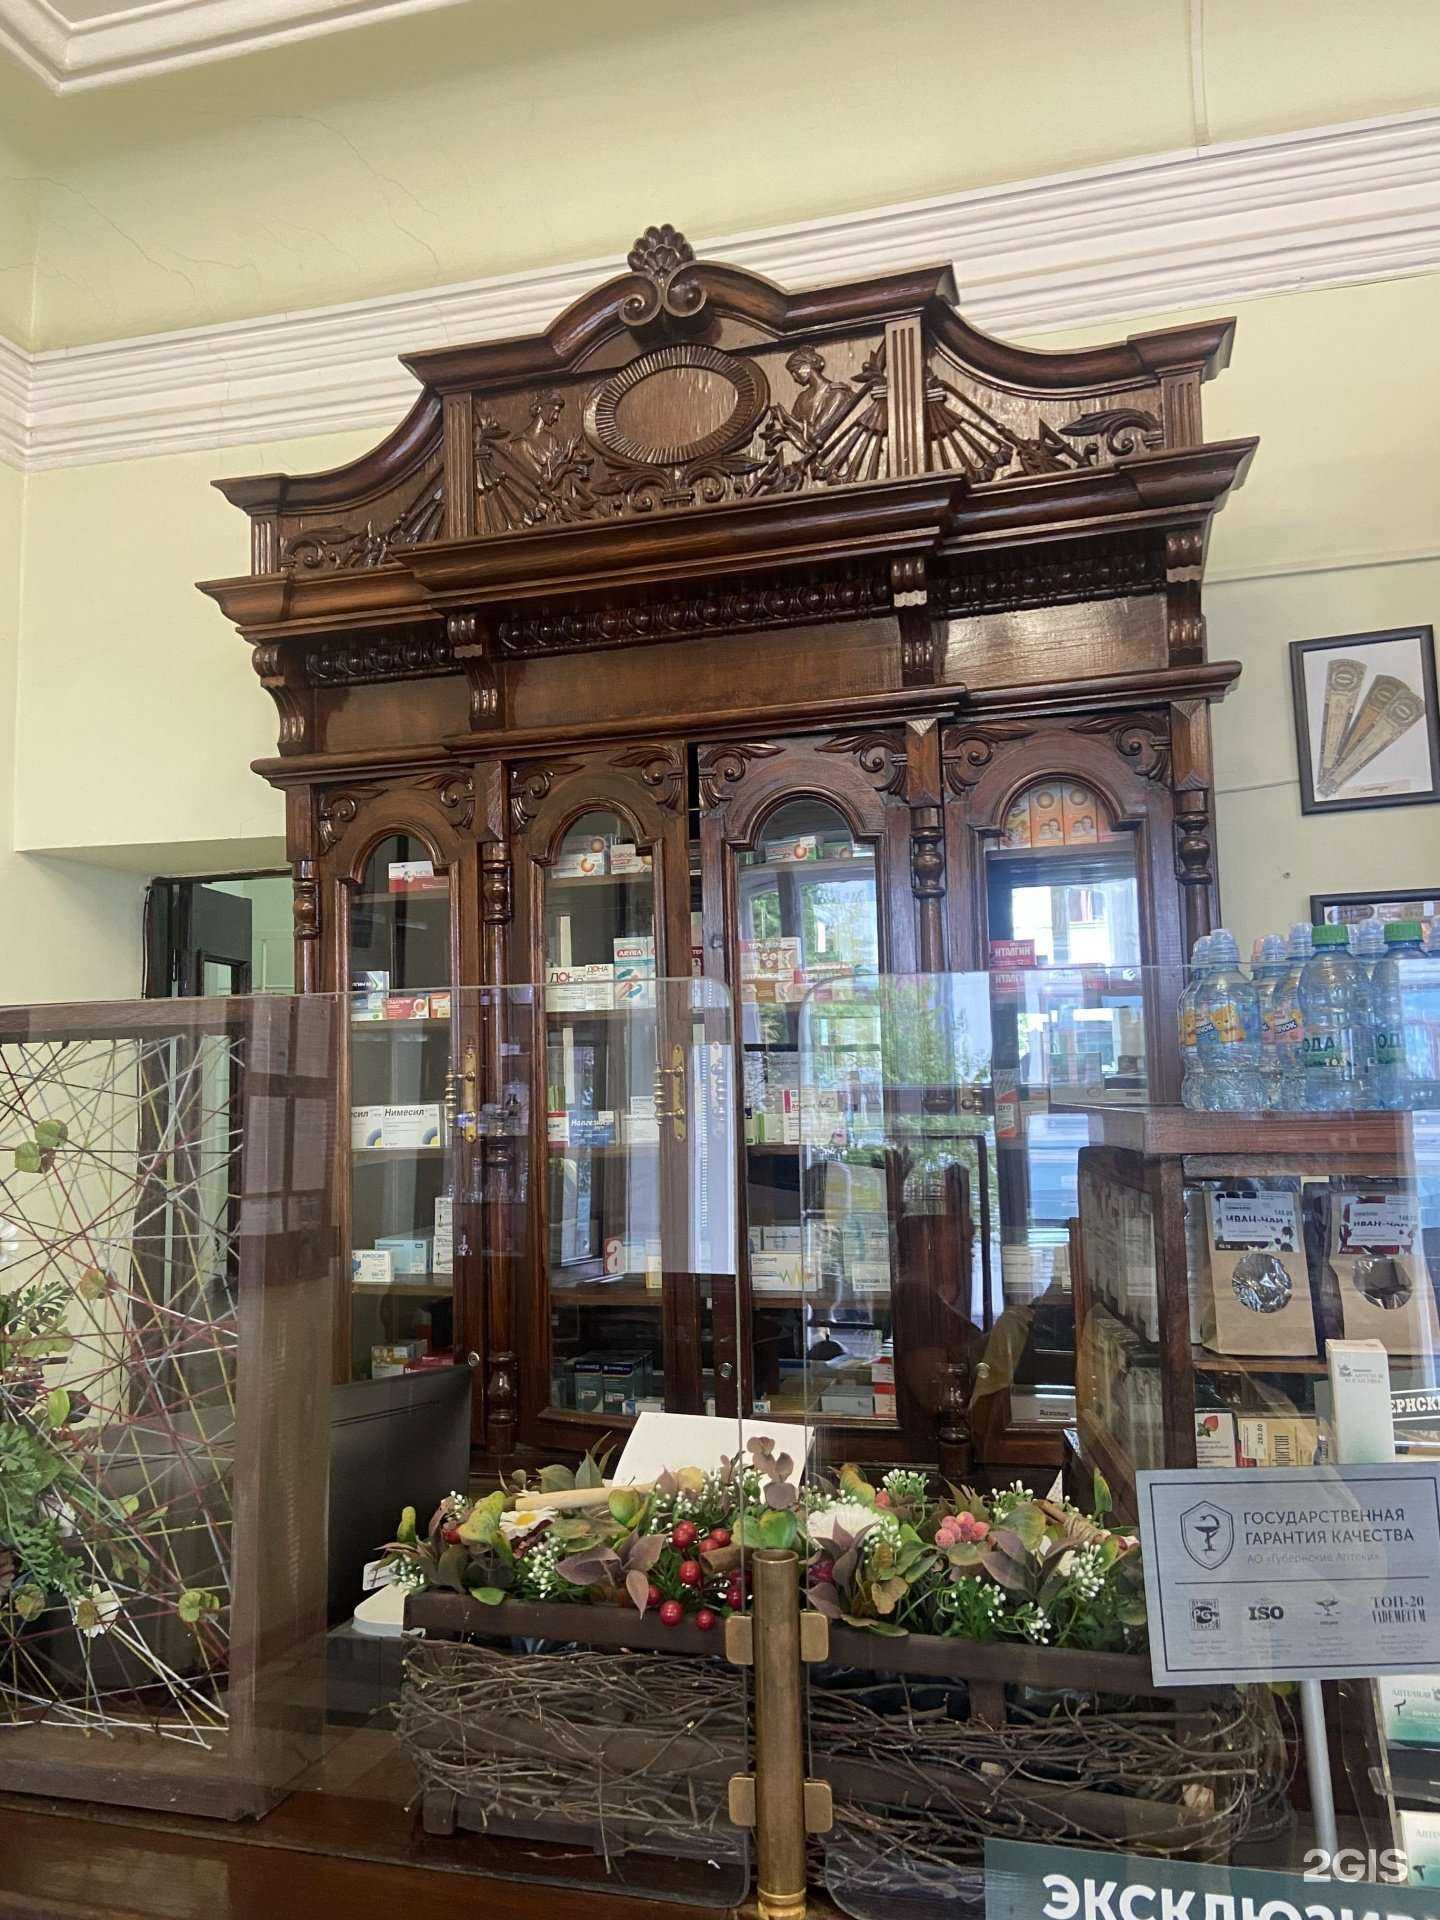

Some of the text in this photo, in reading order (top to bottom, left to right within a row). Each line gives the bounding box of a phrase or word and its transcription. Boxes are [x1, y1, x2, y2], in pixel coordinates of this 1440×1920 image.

[995, 948, 1031, 957] НТАЛГИН
[1303, 1036, 1335, 1052] ОДА
[351, 1110, 368, 1118] есил
[385, 1108, 424, 1117] Нимесил
[1391, 1396, 1440, 1413] ЕРНСК
[1243, 1508, 1405, 1526] ГОСУДАРСТВЕННАЯ
[1245, 1528, 1415, 1545] ГАРАНТИЯ КАЧЕСТВА
[1248, 1606, 1284, 1620] ISO
